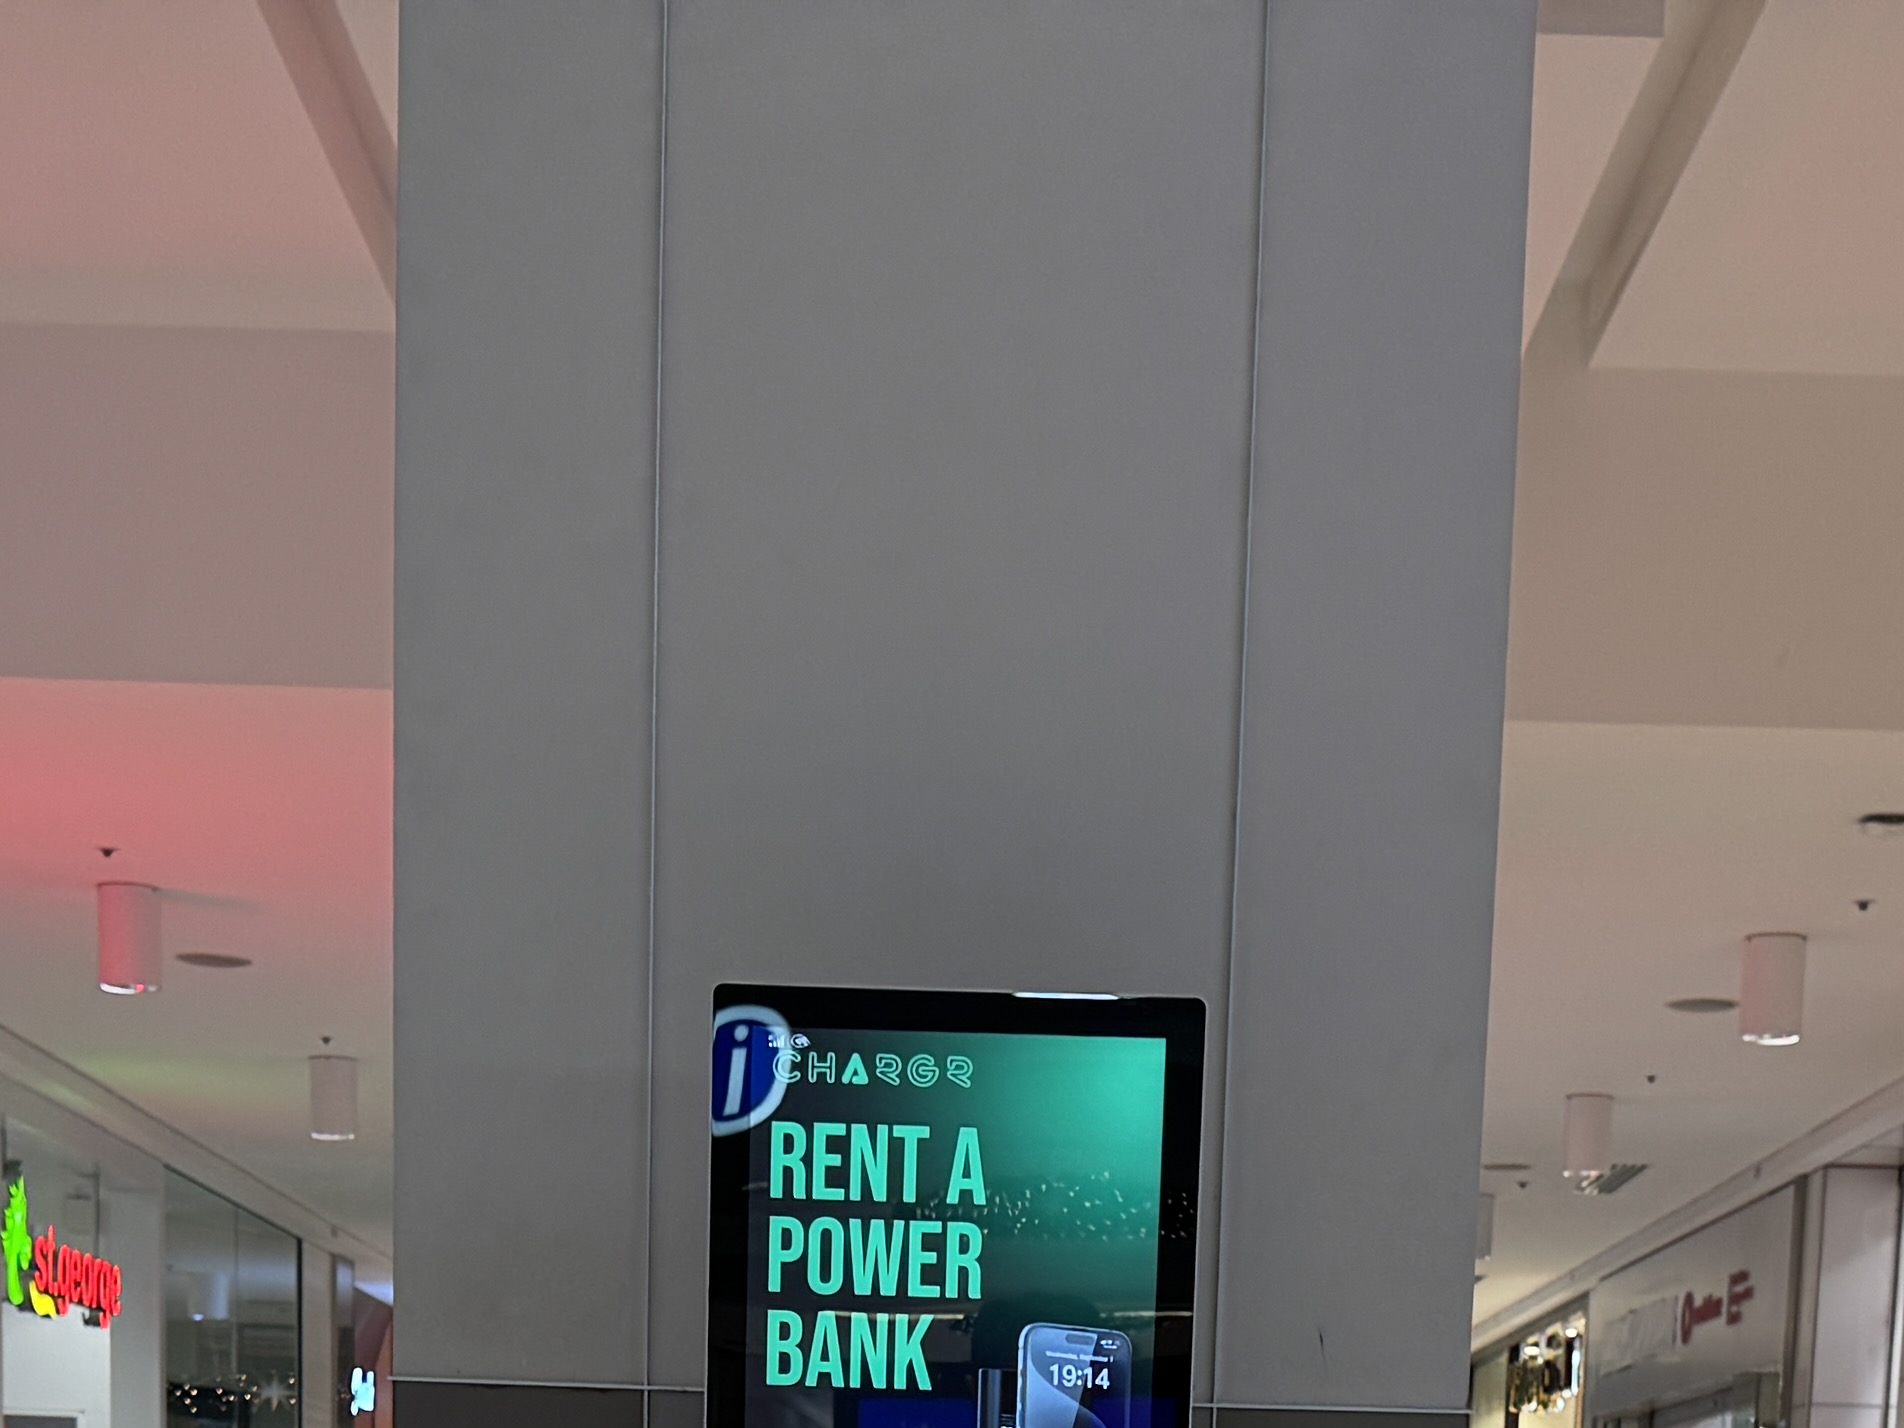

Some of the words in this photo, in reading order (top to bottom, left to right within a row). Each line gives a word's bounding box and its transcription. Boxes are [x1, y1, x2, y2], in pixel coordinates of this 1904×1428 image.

[769, 1121, 930, 1204] RENT
[946, 1127, 987, 1206] A
[767, 1215, 984, 1300] POWER
[765, 1309, 934, 1391] BANK
[1049, 1363, 1110, 1390] 19:14
